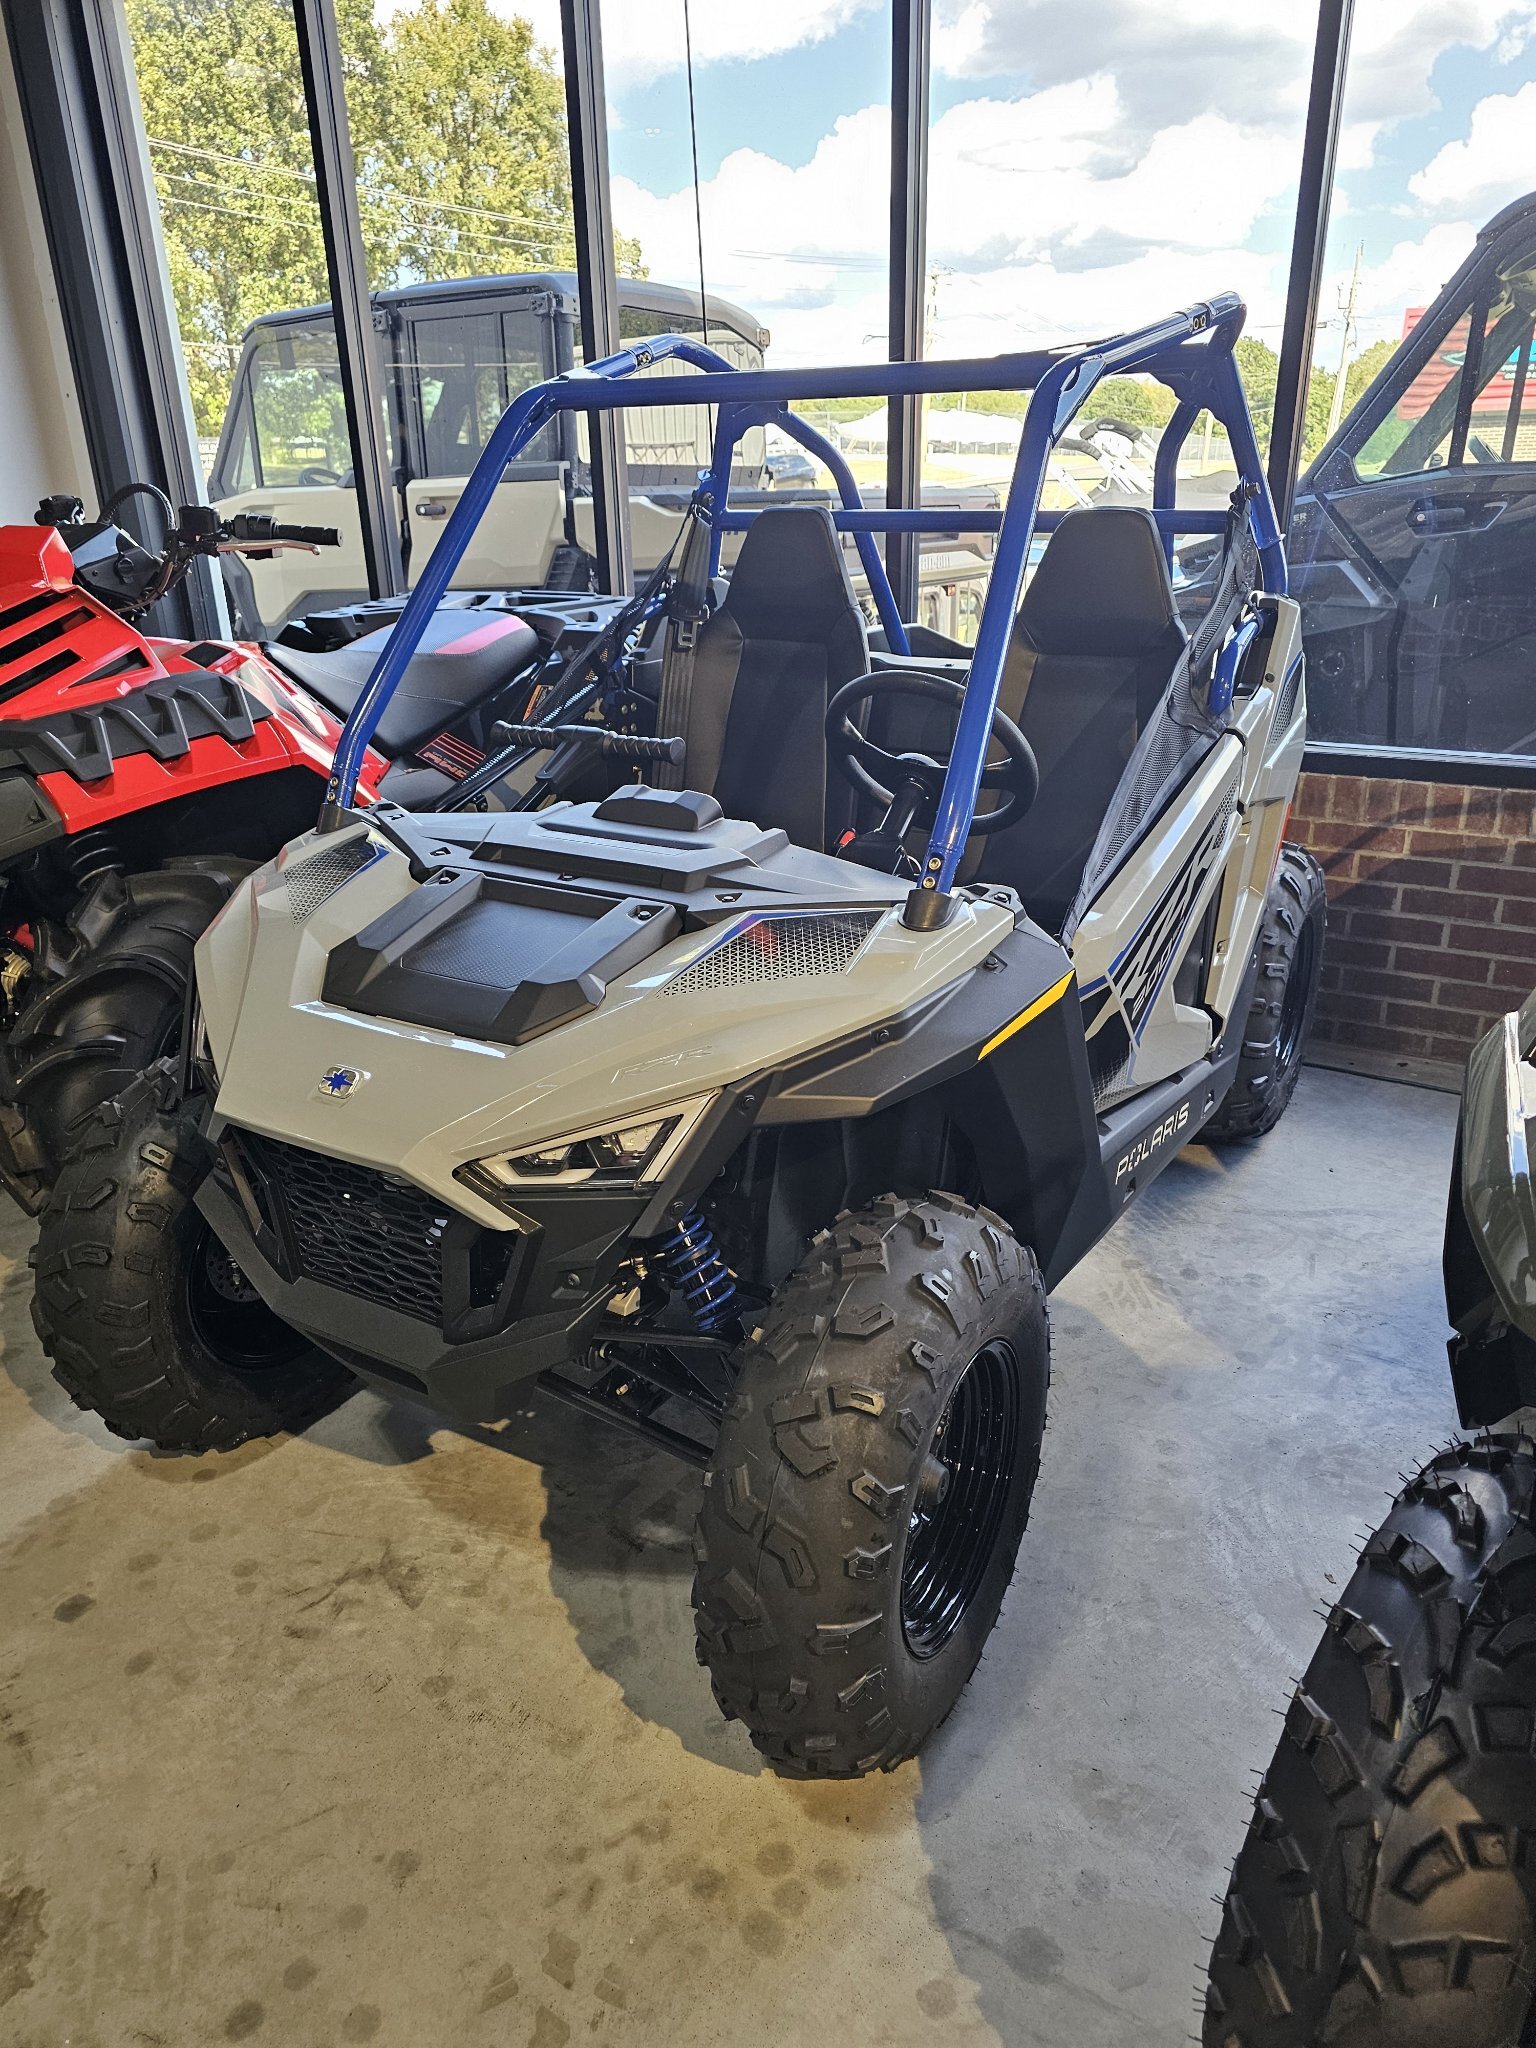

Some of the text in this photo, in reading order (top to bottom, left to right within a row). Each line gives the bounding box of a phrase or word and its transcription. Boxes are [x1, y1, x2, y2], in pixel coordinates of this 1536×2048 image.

[1115, 812, 1227, 1000] RZR
[1131, 937, 1172, 1021] 200
[1115, 1101, 1190, 1186] POLARIS
